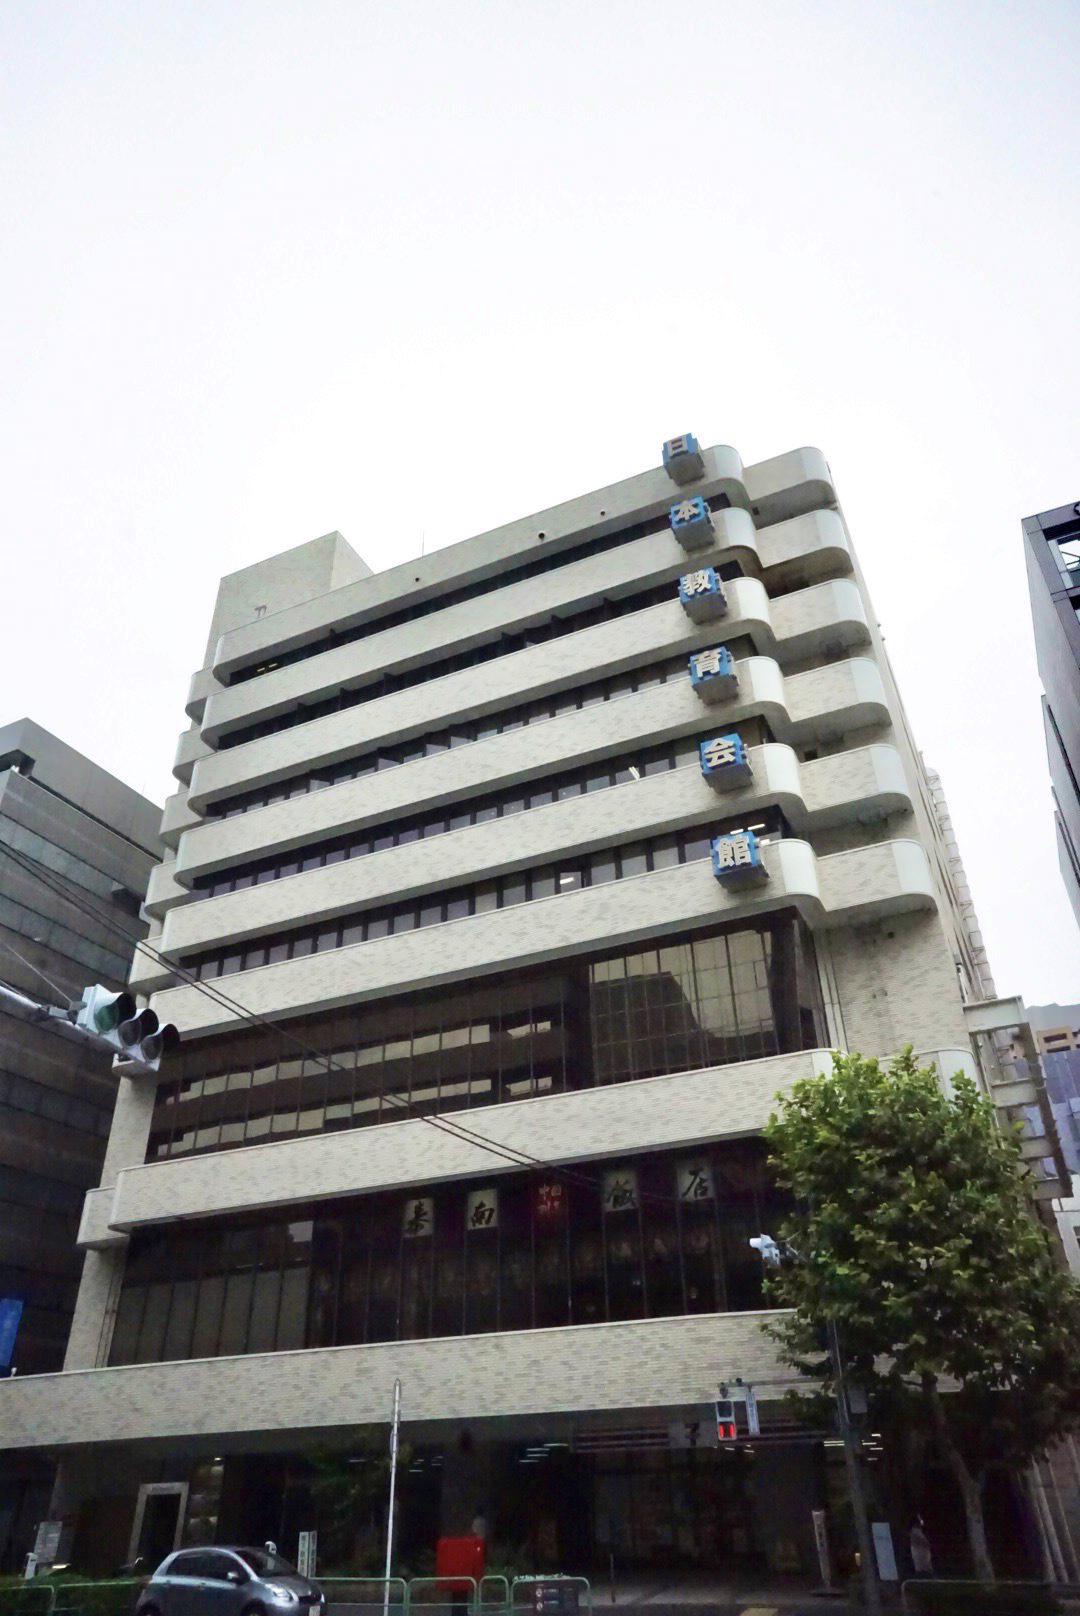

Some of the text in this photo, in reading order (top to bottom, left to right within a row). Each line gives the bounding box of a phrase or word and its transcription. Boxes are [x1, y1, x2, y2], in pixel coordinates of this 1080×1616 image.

[668, 435, 752, 868] 日本教育会館
